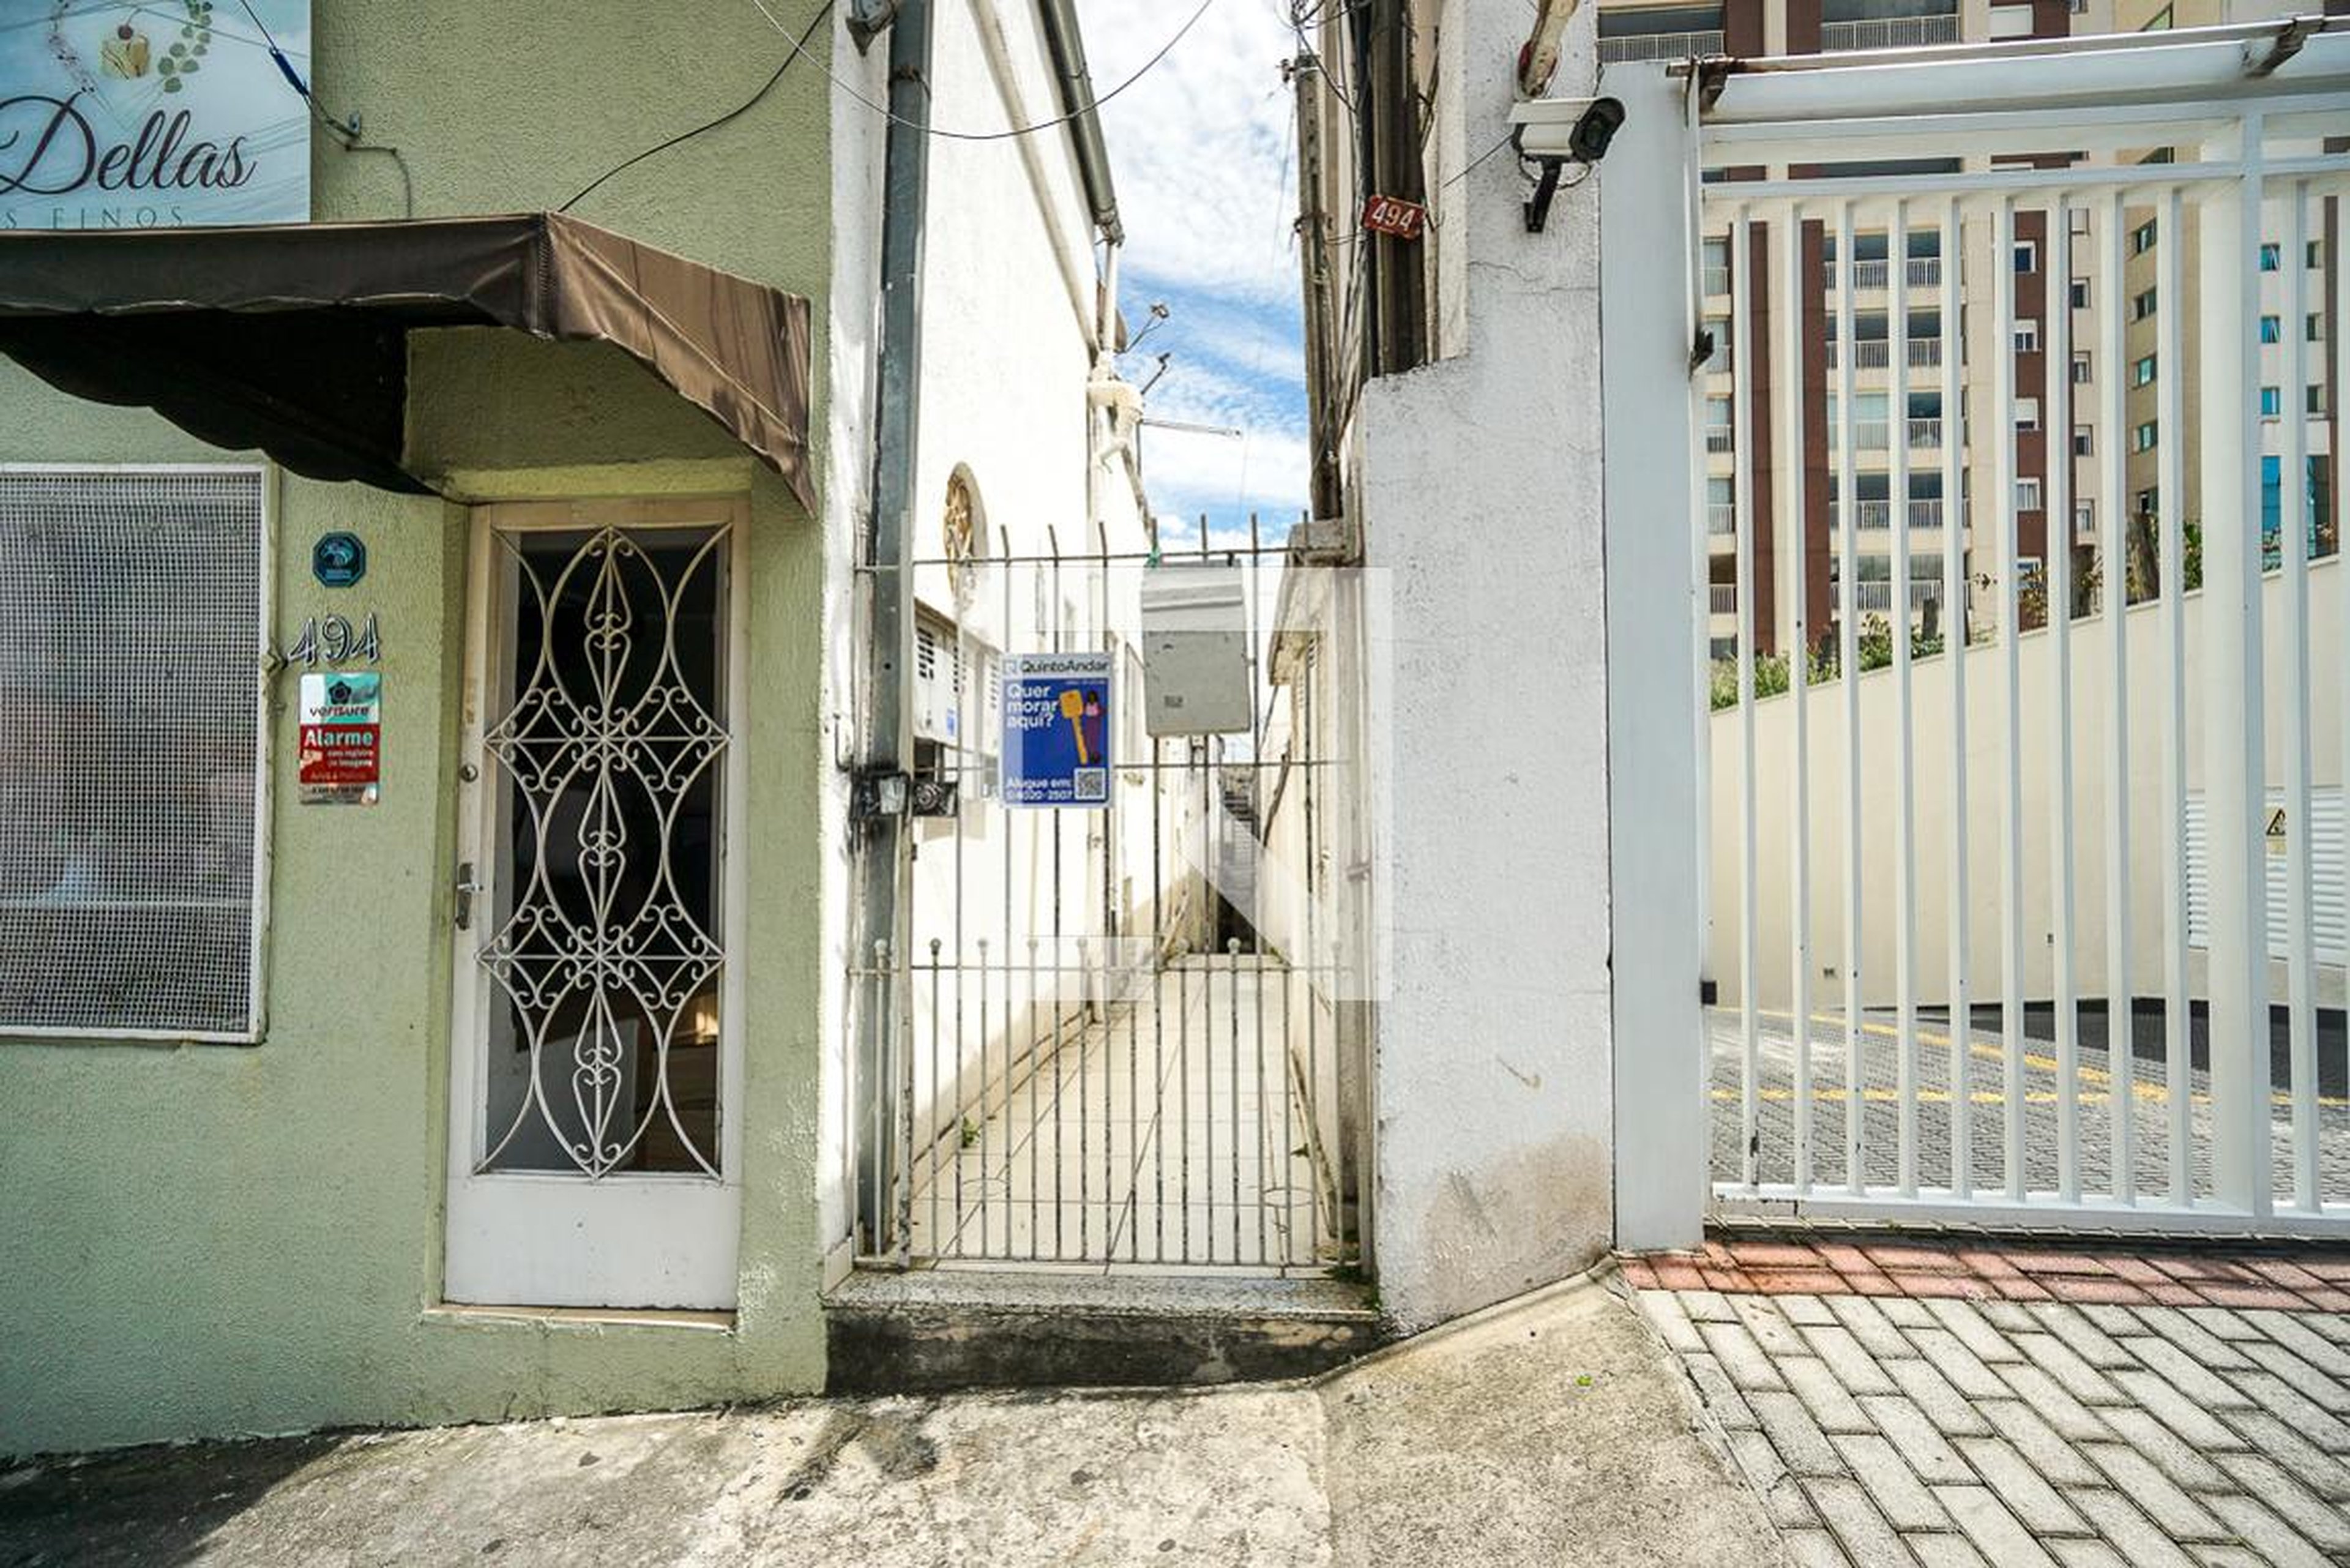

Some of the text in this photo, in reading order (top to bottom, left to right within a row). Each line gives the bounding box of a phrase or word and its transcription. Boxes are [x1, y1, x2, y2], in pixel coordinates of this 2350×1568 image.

[0, 91, 258, 195] Dellas
[53, 205, 183, 229] FINOS
[1372, 201, 1415, 231] 494
[288, 613, 379, 666] 494
[1021, 659, 1109, 673] QuintoAndar
[1007, 684, 1051, 698] Quer
[1007, 701, 1059, 713] morar
[1007, 712, 1054, 731] aqui?
[304, 728, 373, 747] Alarme
